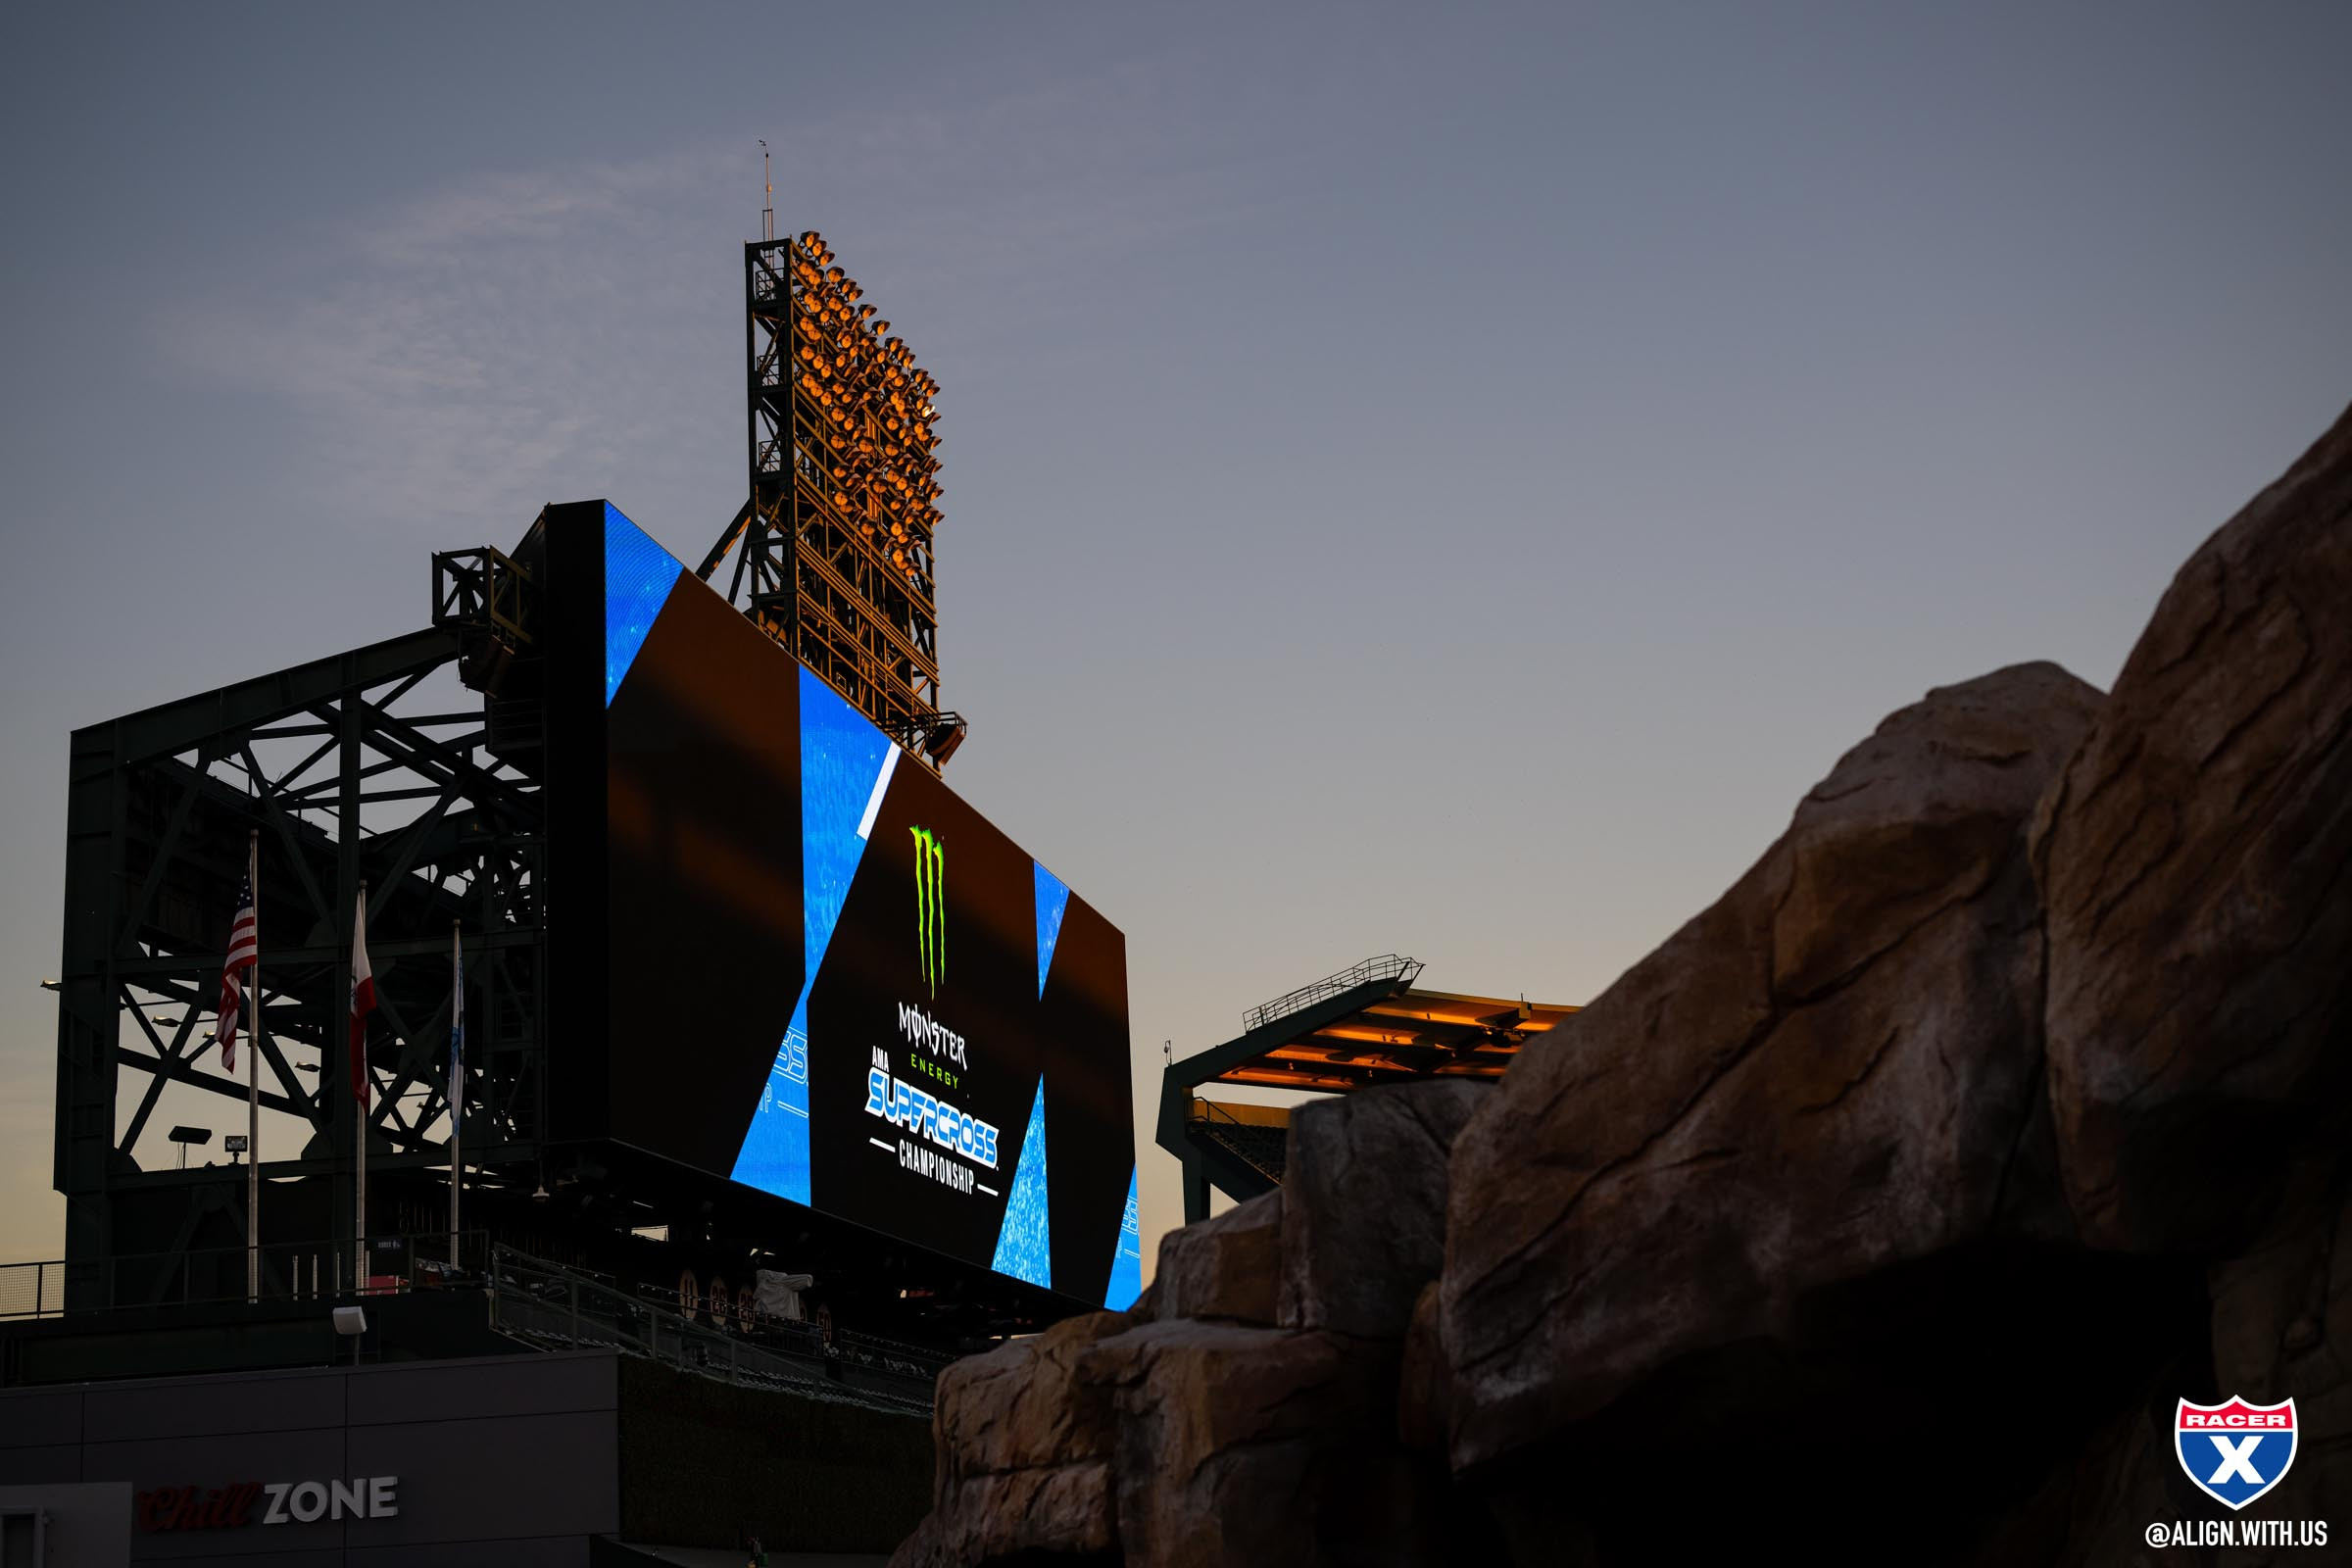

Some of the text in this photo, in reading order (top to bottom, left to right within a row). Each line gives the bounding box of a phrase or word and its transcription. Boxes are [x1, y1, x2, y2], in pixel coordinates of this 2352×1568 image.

[872, 1046, 889, 1072] AMA
[910, 1054, 958, 1090] ENERGY
[864, 1066, 999, 1169] SUPERCROSS
[899, 1139, 974, 1195] CHAMPIONSHIP
[138, 1476, 399, 1533] Chill ZONE
